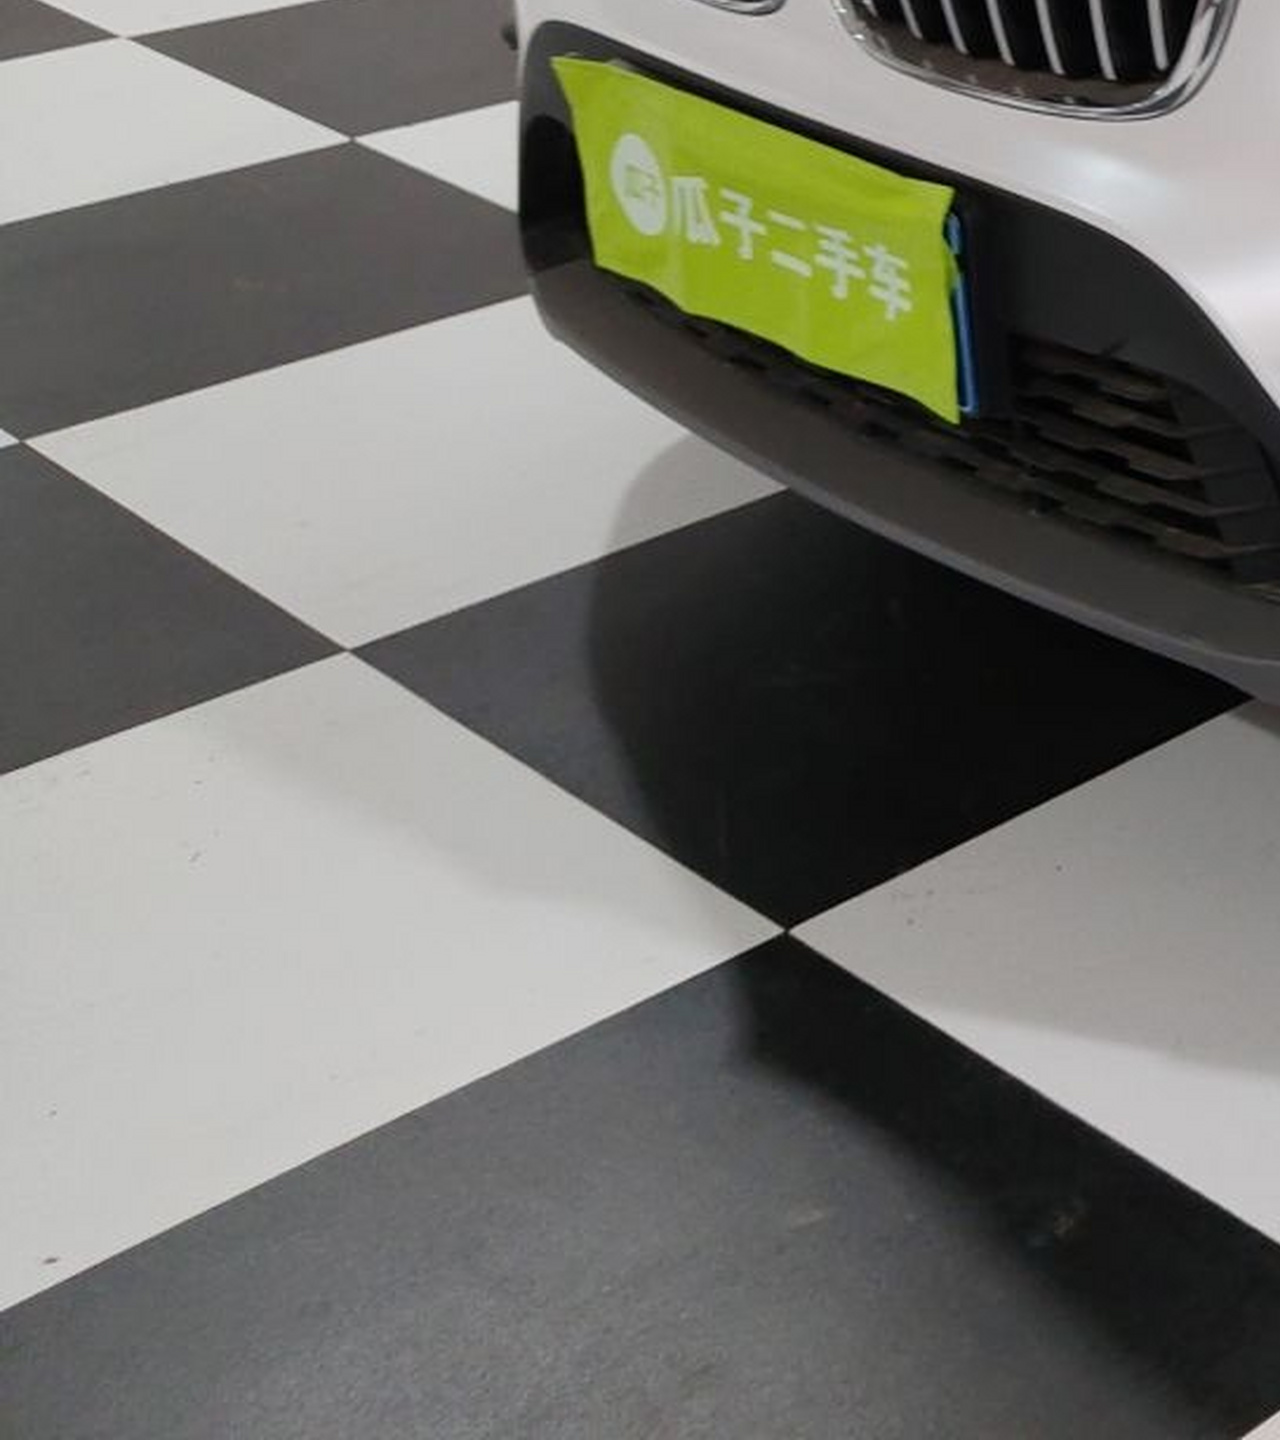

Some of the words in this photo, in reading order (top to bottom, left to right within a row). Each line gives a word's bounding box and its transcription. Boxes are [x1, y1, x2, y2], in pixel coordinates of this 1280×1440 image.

[670, 176, 912, 322] 瓜子二手车
